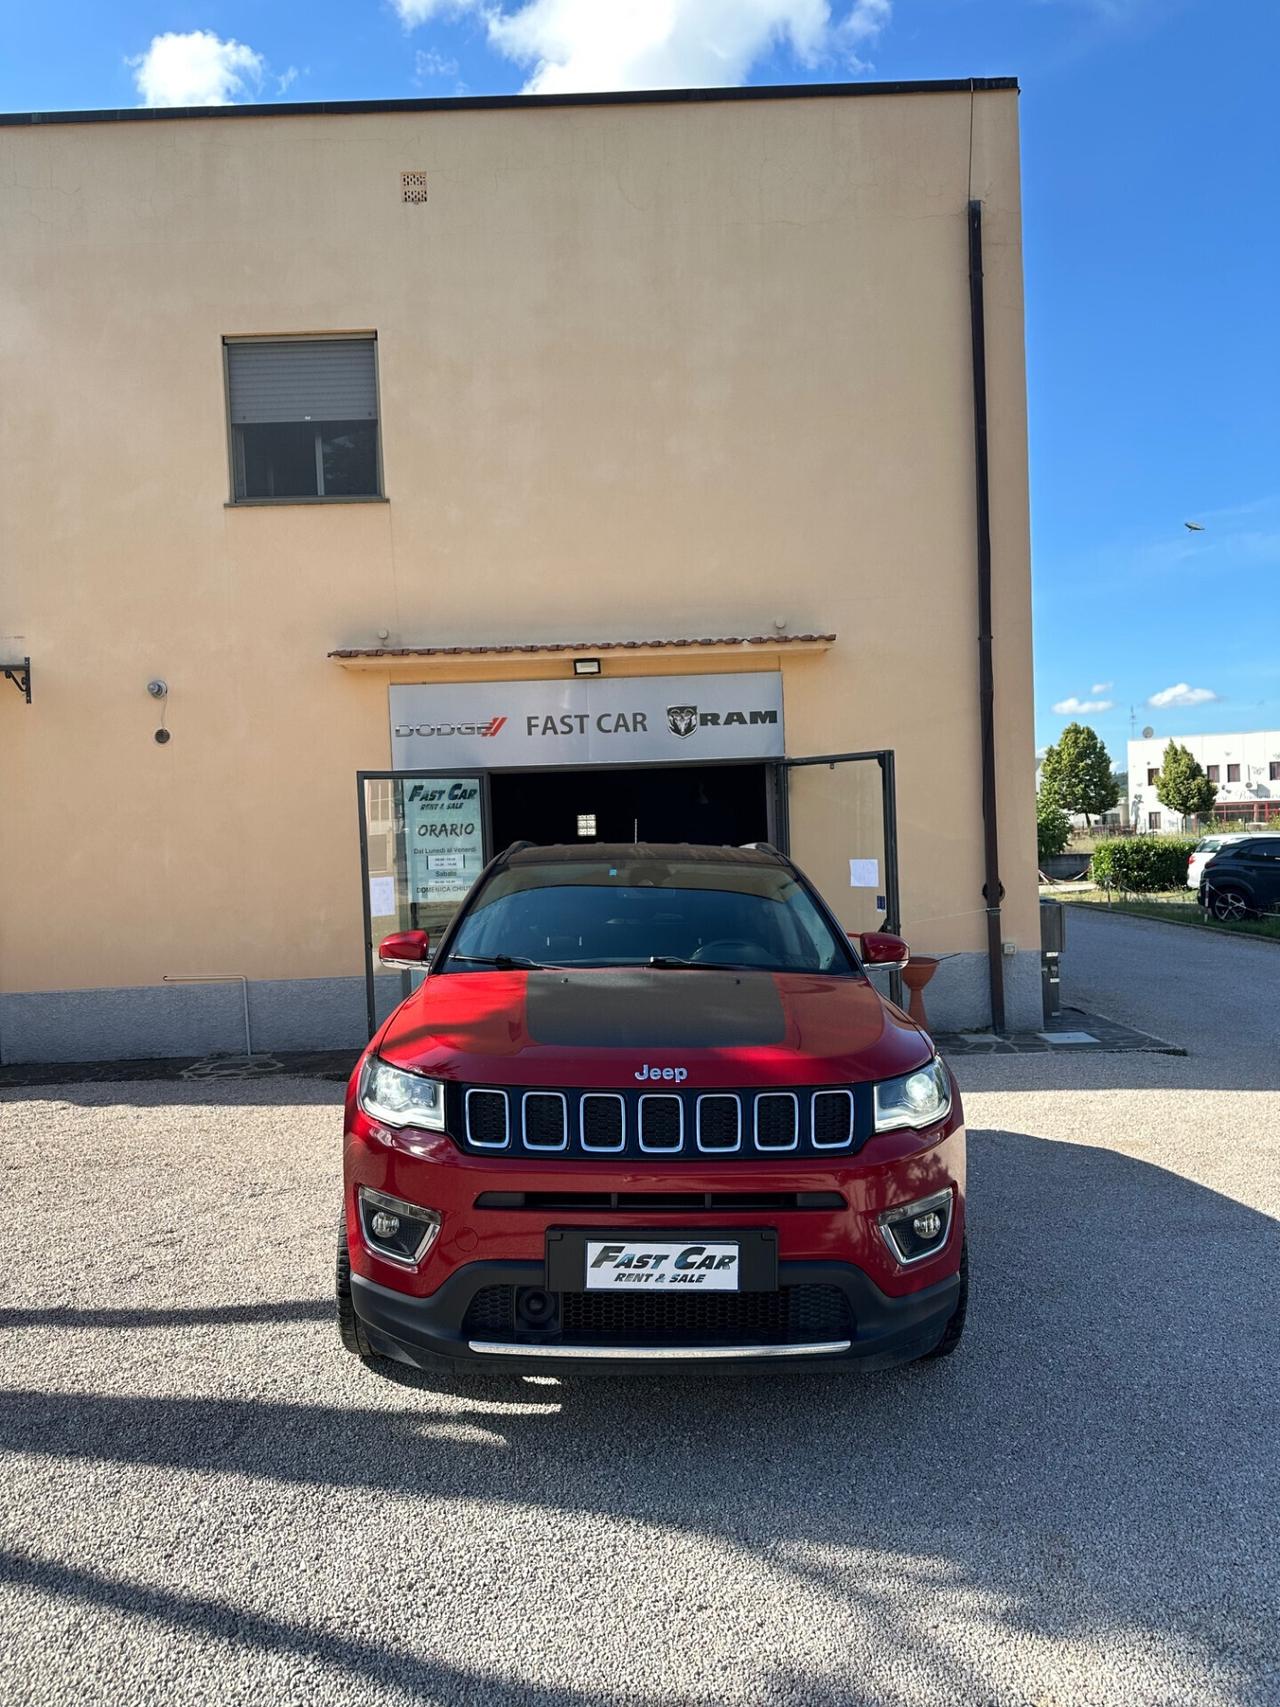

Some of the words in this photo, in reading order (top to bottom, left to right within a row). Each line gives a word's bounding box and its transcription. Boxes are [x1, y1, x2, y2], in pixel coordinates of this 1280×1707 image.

[526, 714, 590, 736] FAST
[596, 712, 648, 734] CAR
[699, 710, 778, 726] RAM
[395, 721, 496, 738] DODGE
[408, 784, 446, 802] FAST
[448, 783, 478, 800] CAR
[418, 823, 475, 838] ORARIO
[634, 1064, 688, 1083] Jeep
[590, 1245, 670, 1271] FAST
[674, 1246, 737, 1271] CAR
[614, 1273, 654, 1283] RENT
[655, 1274, 666, 1283] &
[669, 1273, 707, 1283] SALE
